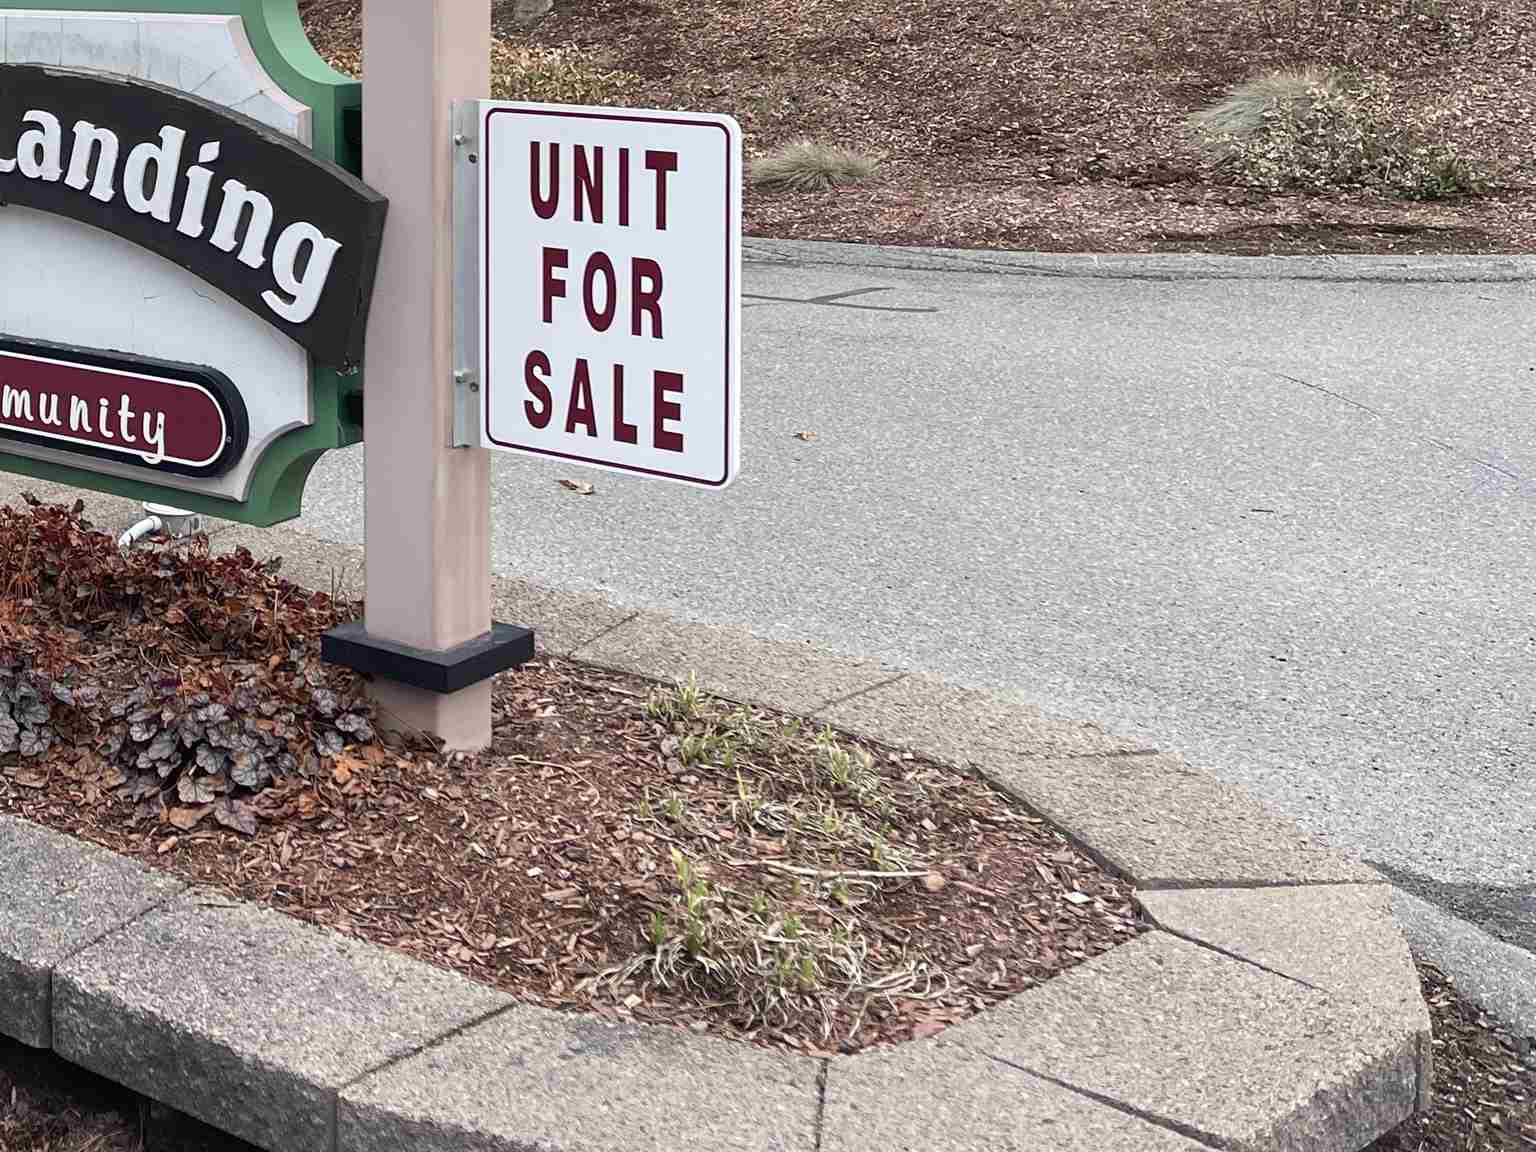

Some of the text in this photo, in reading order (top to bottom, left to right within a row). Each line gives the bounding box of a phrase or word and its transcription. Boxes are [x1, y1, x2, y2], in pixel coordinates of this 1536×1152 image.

[530, 140, 678, 230] UNIT
[542, 246, 664, 339] FOR
[523, 349, 684, 453] SALE
